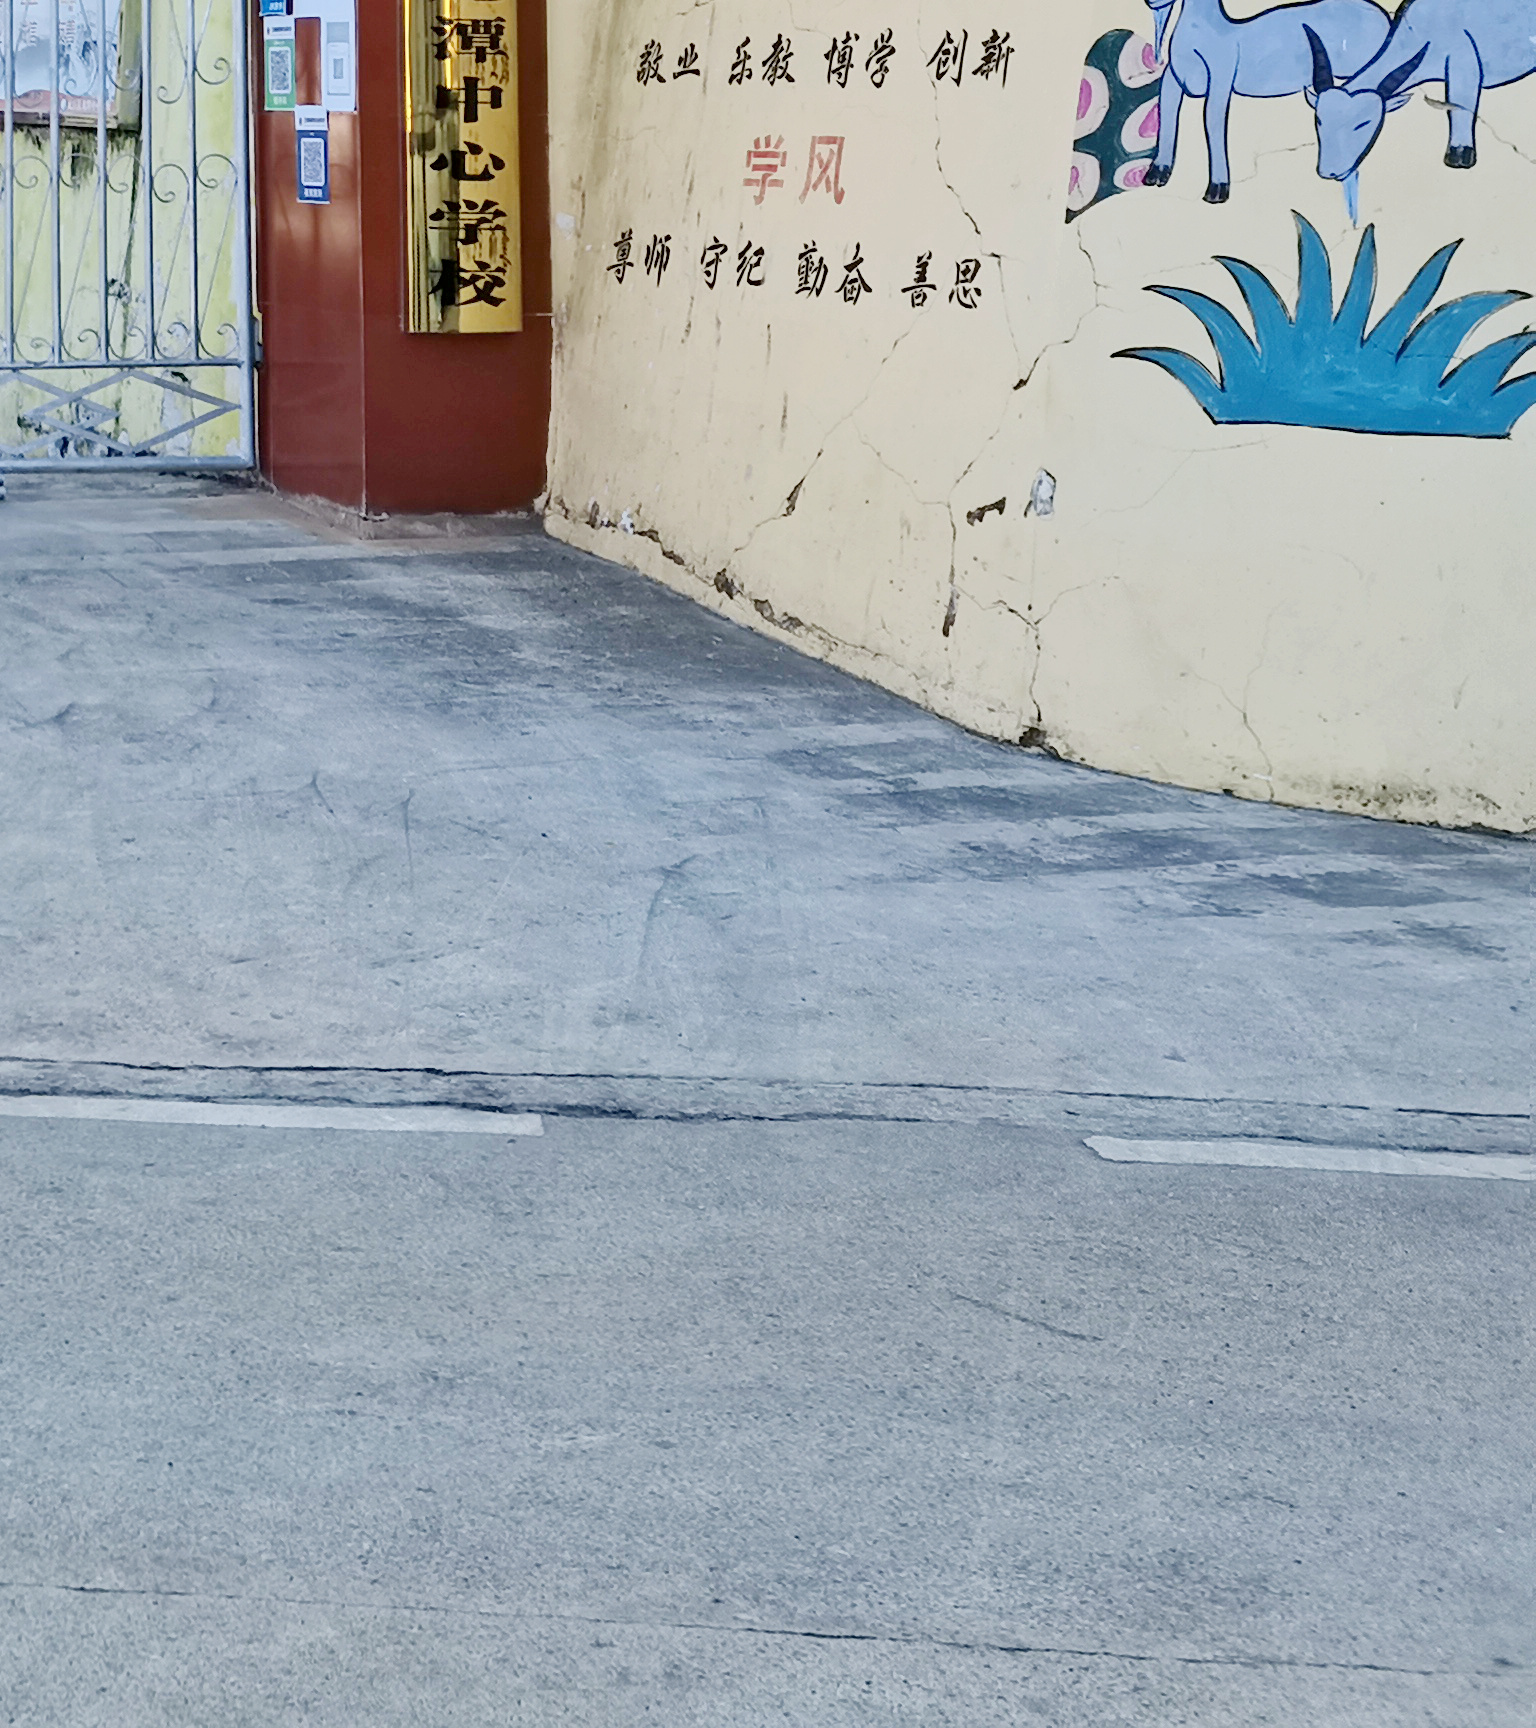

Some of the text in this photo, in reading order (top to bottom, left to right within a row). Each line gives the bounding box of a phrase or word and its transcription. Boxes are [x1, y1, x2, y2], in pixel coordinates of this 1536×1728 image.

[635, 27, 1016, 90] 敬业 乐教 博学 创新
[742, 133, 847, 207] 学风
[606, 230, 985, 311] 尊师 守纪 勤奋 善思
